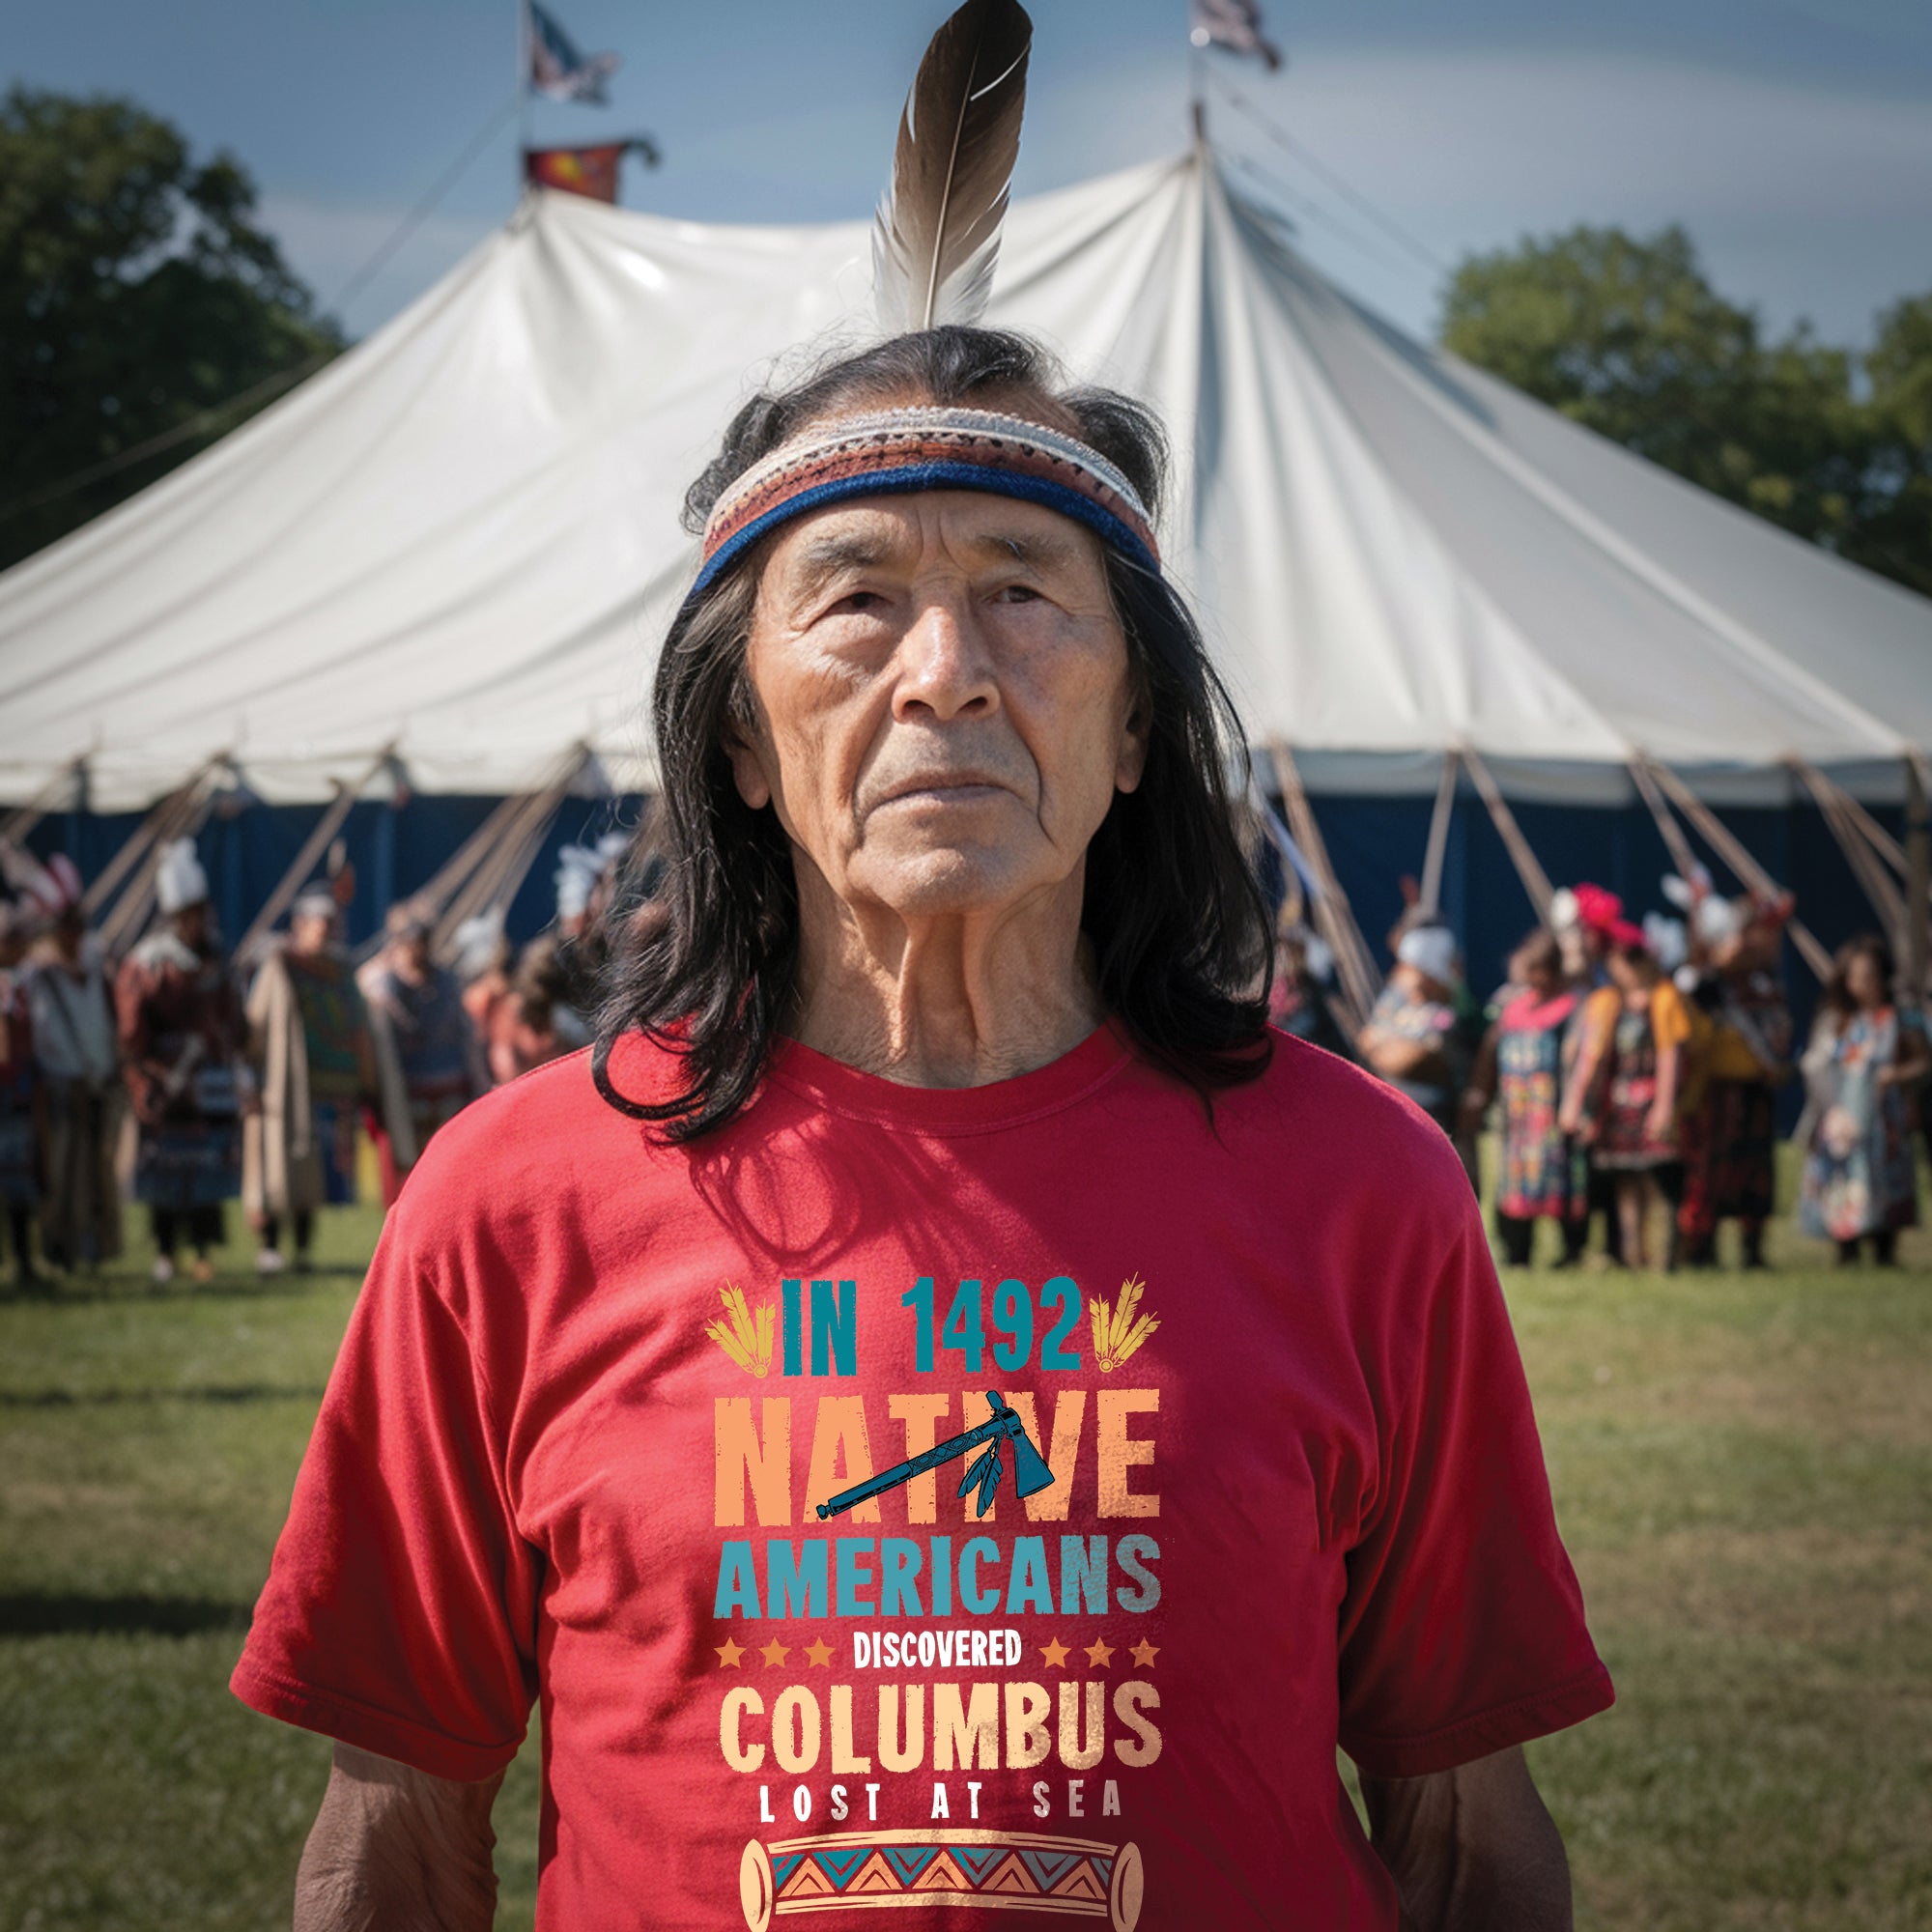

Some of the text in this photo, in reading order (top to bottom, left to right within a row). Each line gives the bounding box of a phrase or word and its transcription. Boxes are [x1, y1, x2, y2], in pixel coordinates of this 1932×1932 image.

[781, 1276, 1082, 1377] IN 1492
[714, 1388, 1160, 1526] NATIVE
[713, 1533, 1161, 1619] AMERICANS
[854, 1629, 1022, 1669] DISCOVERED
[719, 1680, 1162, 1775] COLUMBUS
[759, 1779, 1121, 1823] LOST AT SEA
